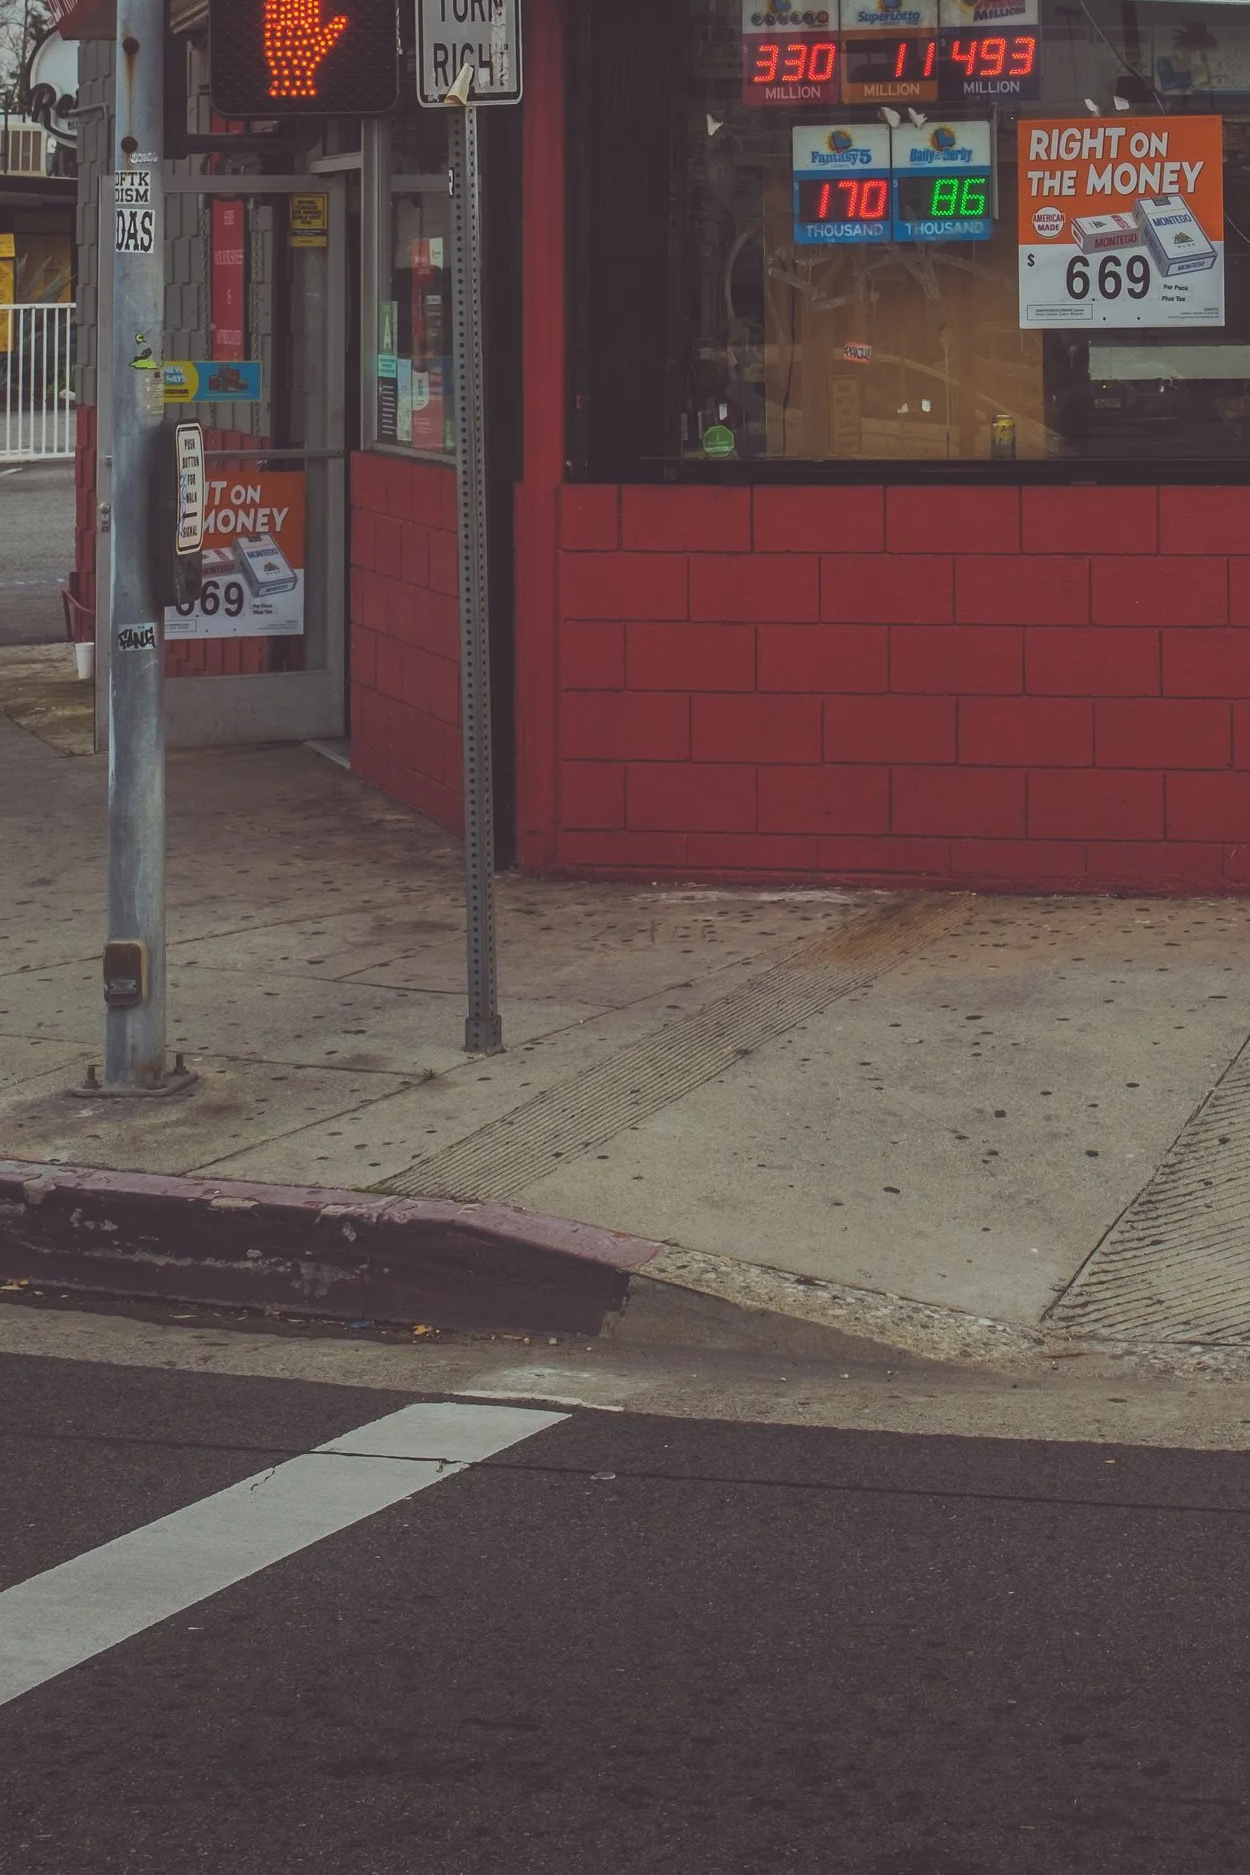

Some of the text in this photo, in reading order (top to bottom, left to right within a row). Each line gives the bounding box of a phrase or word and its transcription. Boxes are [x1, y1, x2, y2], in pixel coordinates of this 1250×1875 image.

[753, 42, 836, 83] 330
[895, 41, 936, 78] 11
[951, 36, 1037, 76] 493
[433, 42, 509, 88] RIGH
[765, 86, 821, 100] MILLION
[863, 83, 920, 98] MILLION
[963, 80, 1020, 94] MILLION
[1029, 127, 1169, 162] RIGHT ON
[1027, 161, 1205, 197] THE MONEY
[818, 179, 889, 218] 170
[931, 178, 986, 217] 86
[1033, 213, 1065, 223] AMERICAN
[1152, 213, 1192, 228] MONTEGO
[807, 224, 883, 238] THOUSAND
[905, 221, 984, 235] THOUSAND
[1037, 223, 1060, 231] MADE
[1094, 233, 1138, 249] MONTEGO
[1027, 253, 1035, 267] $
[184, 438, 195, 450] PUSH
[182, 456, 200, 469] BUTTON
[187, 474, 196, 485] FOR
[186, 492, 198, 503] WALK
[230, 484, 262, 505] ON
[182, 525, 198, 538] SIGNAL
